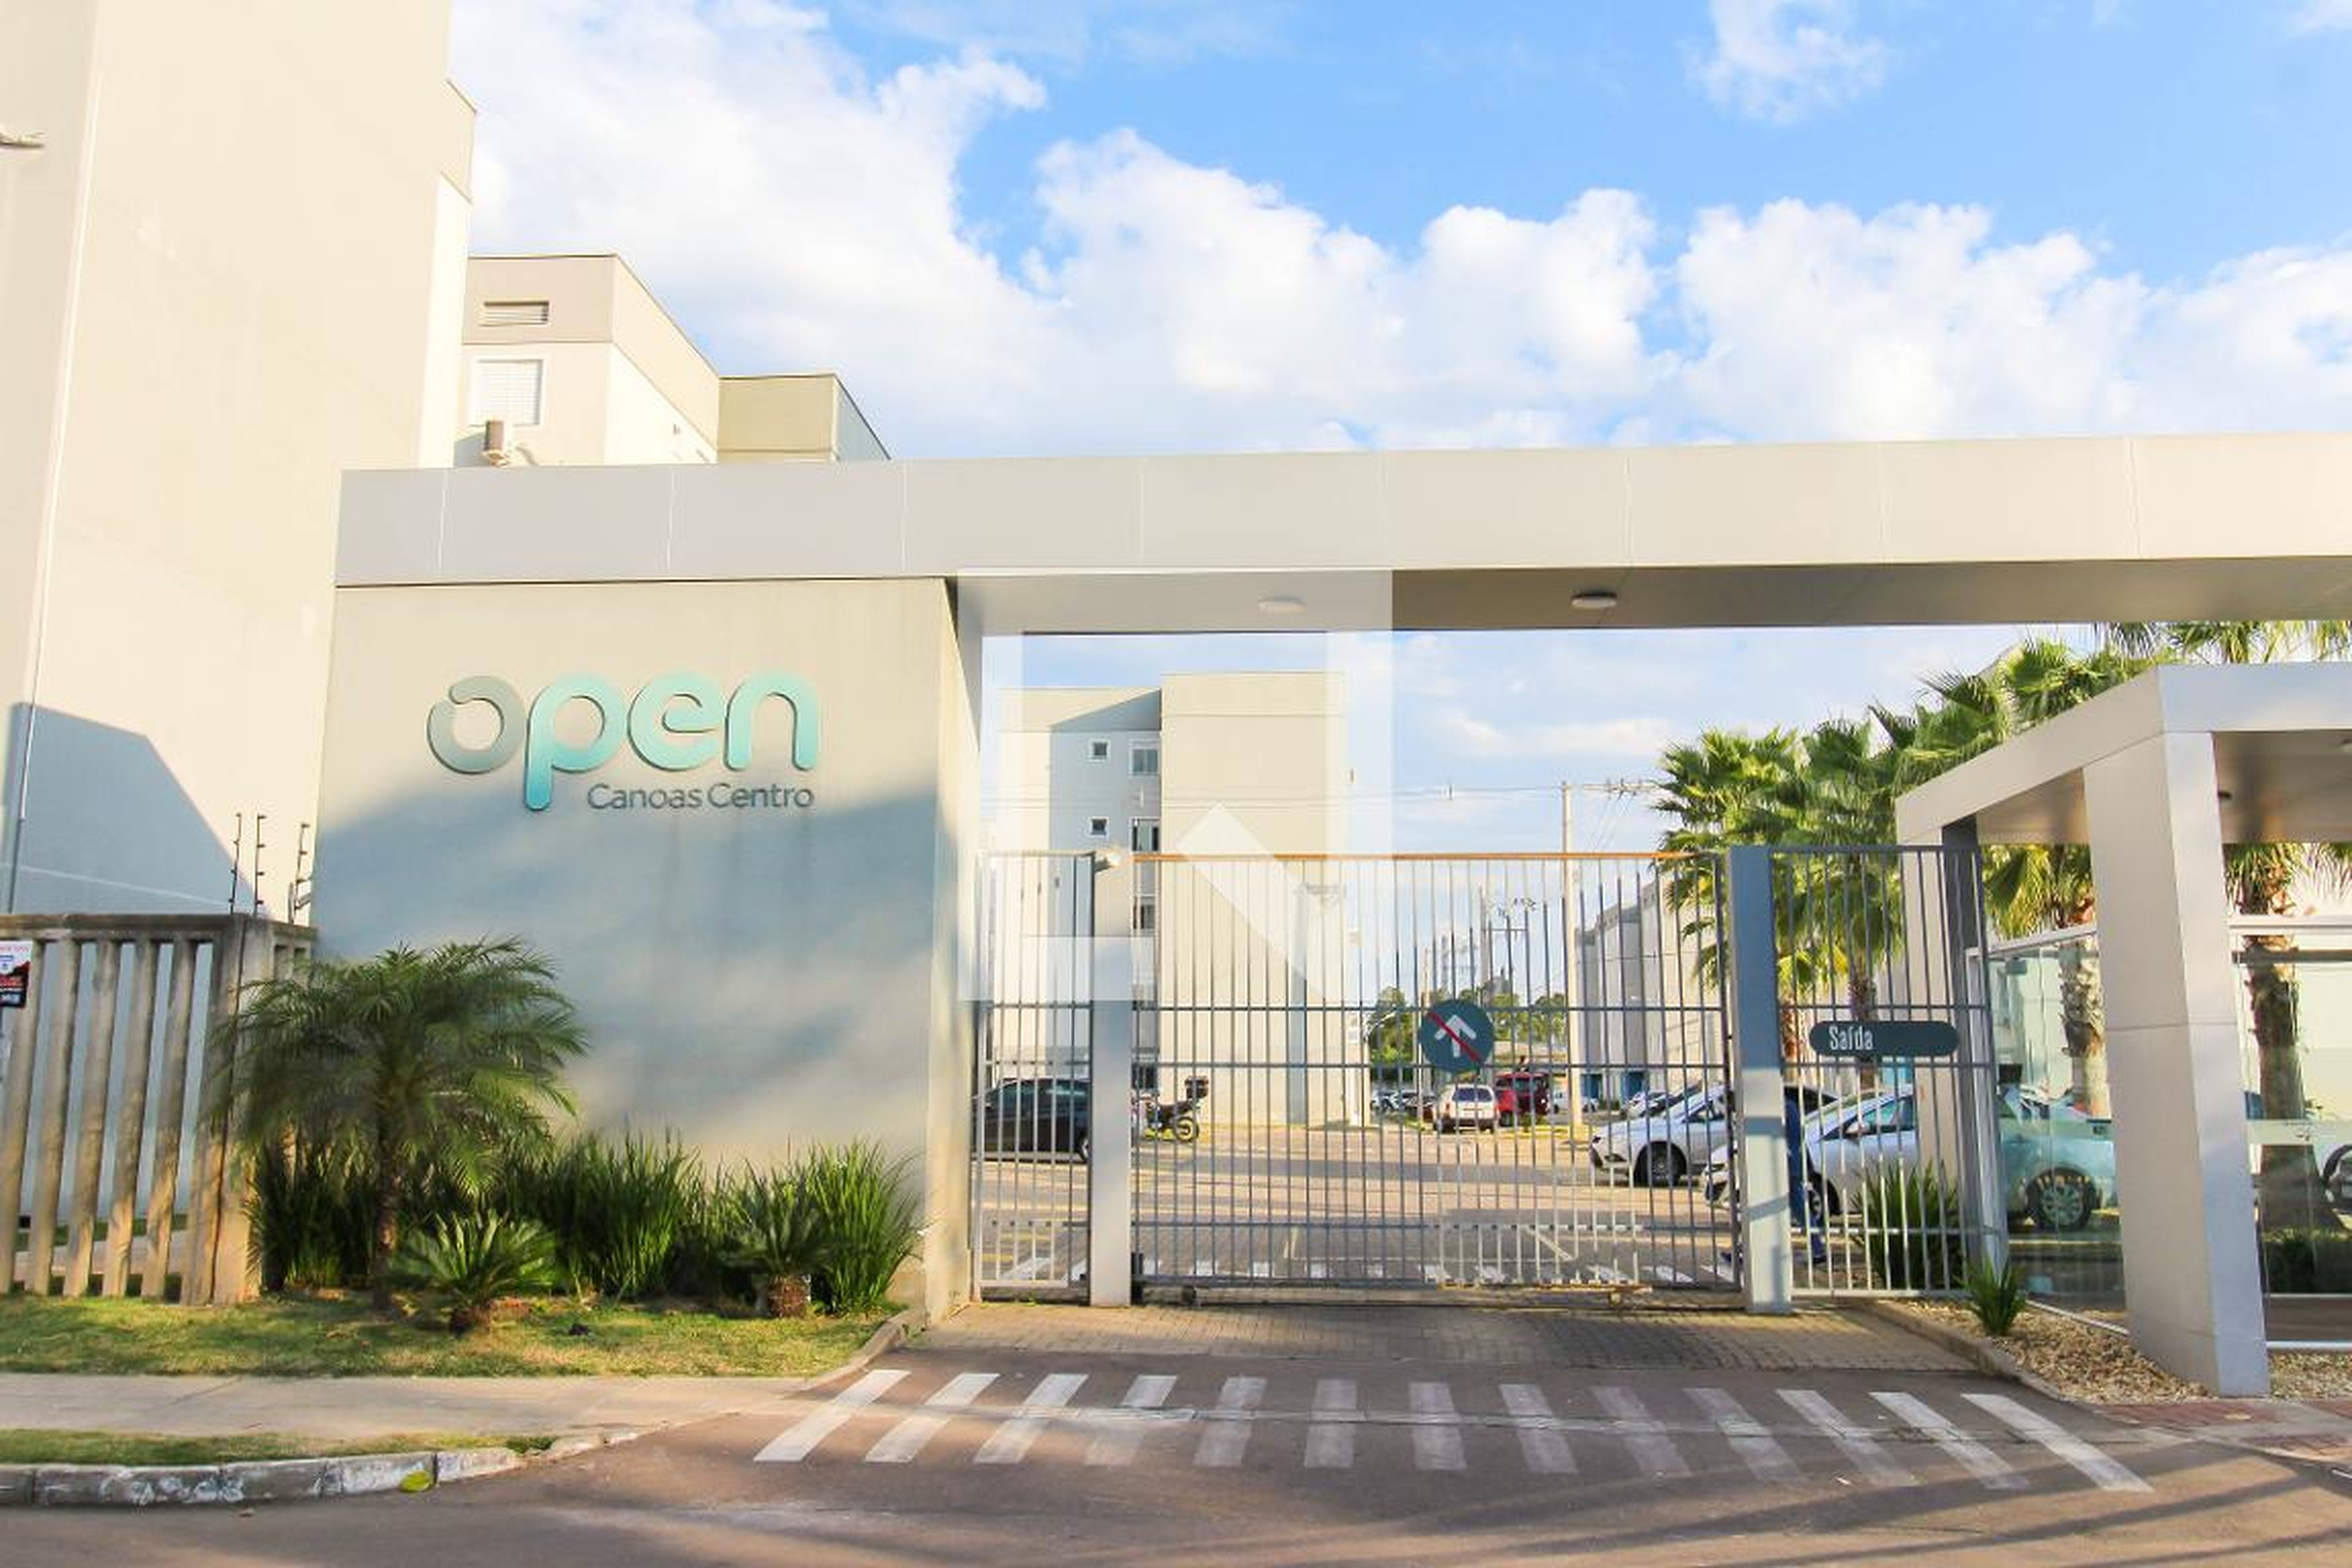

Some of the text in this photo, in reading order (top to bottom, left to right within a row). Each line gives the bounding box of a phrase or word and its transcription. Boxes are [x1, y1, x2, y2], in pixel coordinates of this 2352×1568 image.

[427, 673, 820, 811] open
[587, 783, 815, 810] Canoas Centro
[1829, 1025, 1874, 1050] Saída
